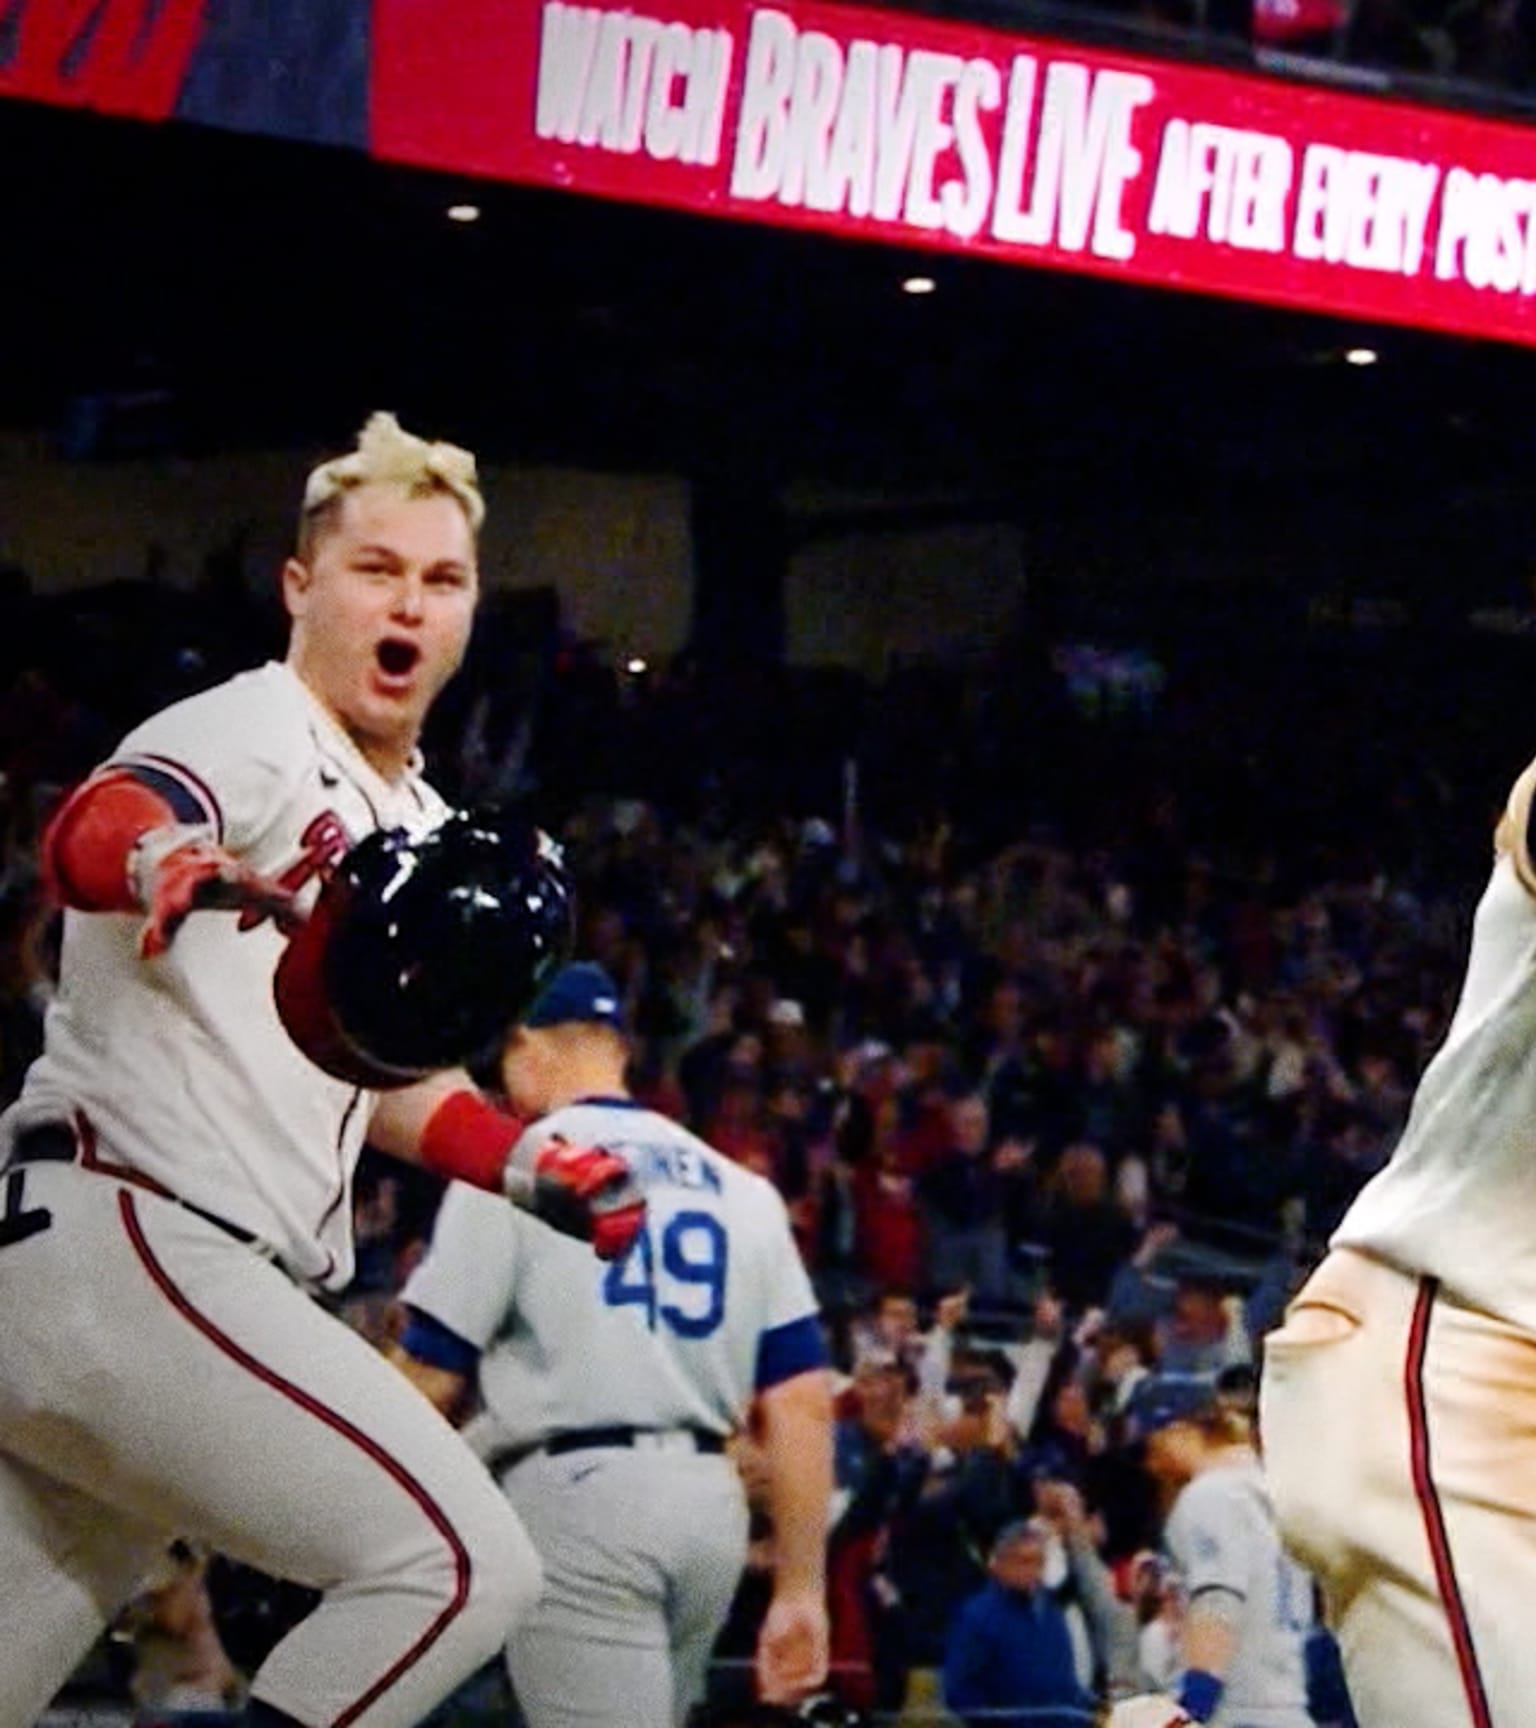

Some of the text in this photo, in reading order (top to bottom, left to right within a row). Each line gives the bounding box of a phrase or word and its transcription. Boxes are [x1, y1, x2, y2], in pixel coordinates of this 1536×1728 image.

[536, 2, 733, 166] WATCH
[731, 9, 1001, 237] BRAVES
[991, 55, 1154, 260] LIVE
[1148, 118, 1293, 252] AFTER
[1293, 143, 1439, 276] EVERY
[604, 1207, 728, 1338] 49
